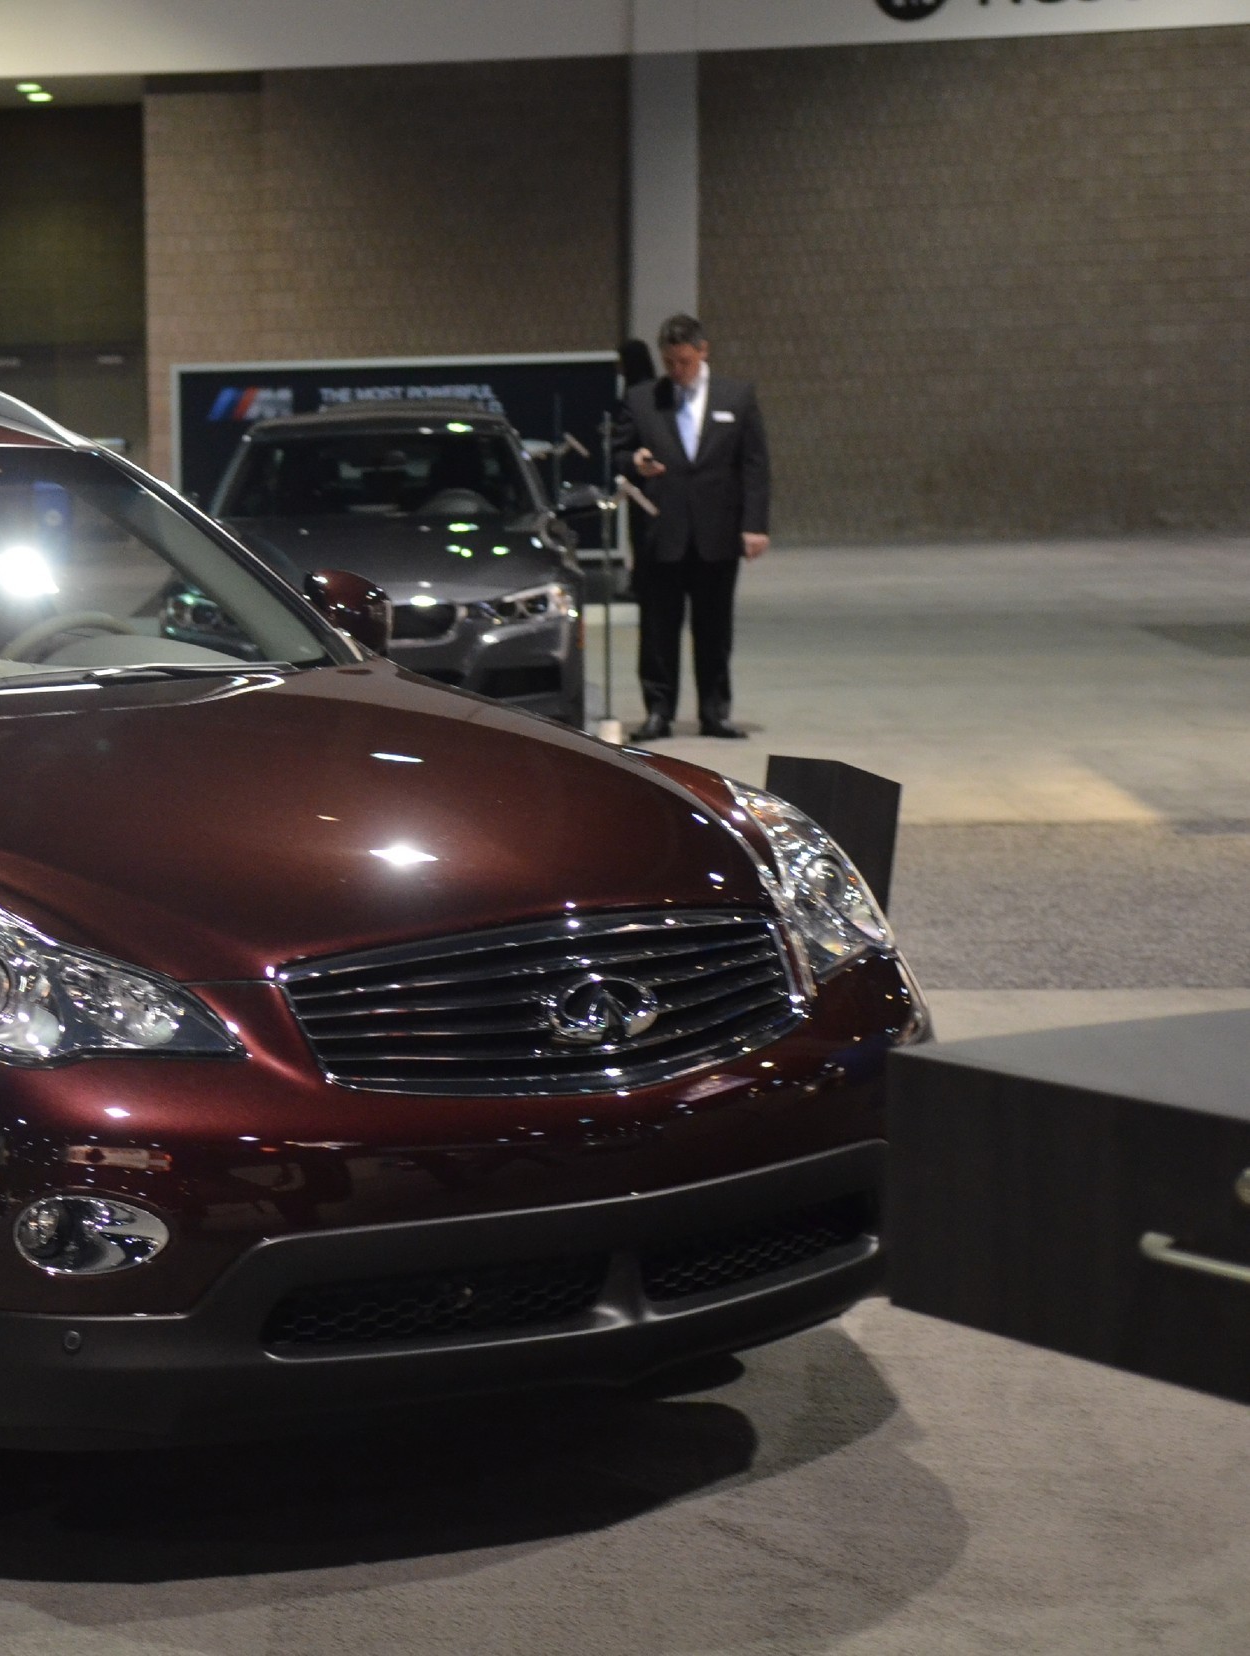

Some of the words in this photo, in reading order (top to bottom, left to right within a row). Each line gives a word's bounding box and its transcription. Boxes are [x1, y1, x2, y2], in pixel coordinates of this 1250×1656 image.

[319, 387, 351, 402] THE
[355, 386, 403, 401] MOST
[406, 384, 493, 400] POWERFUL
